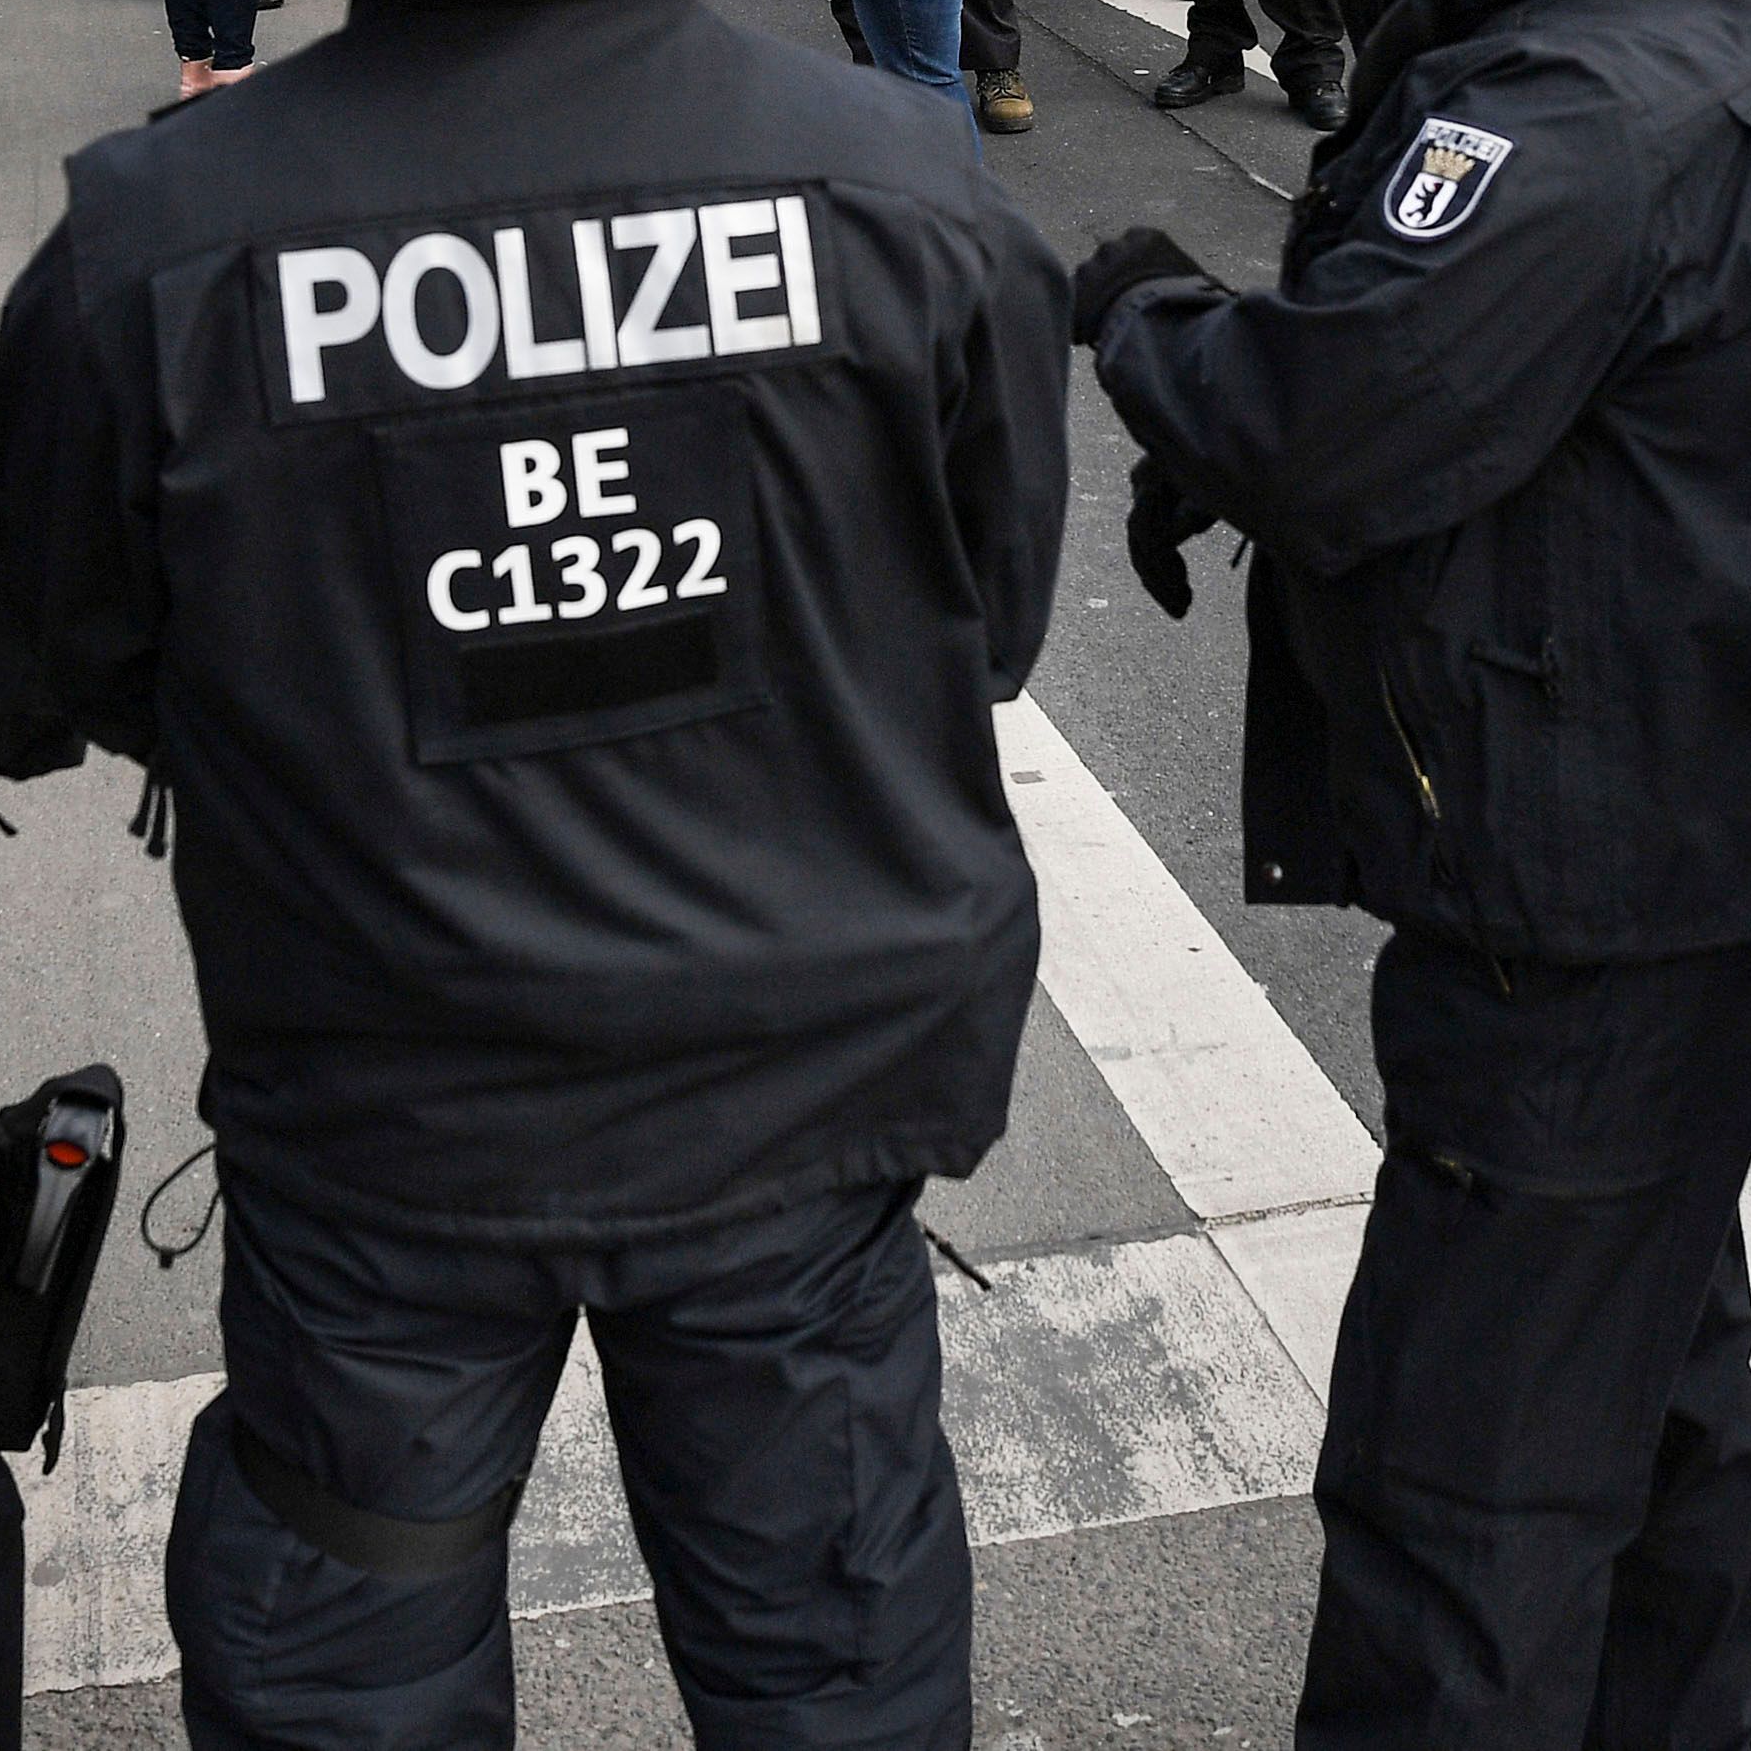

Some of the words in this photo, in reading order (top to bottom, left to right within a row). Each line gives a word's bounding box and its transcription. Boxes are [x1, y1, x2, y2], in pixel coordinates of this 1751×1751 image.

[277, 195, 823, 403] POLIZEI
[500, 427, 637, 528] BE
[427, 518, 728, 631] C1322
